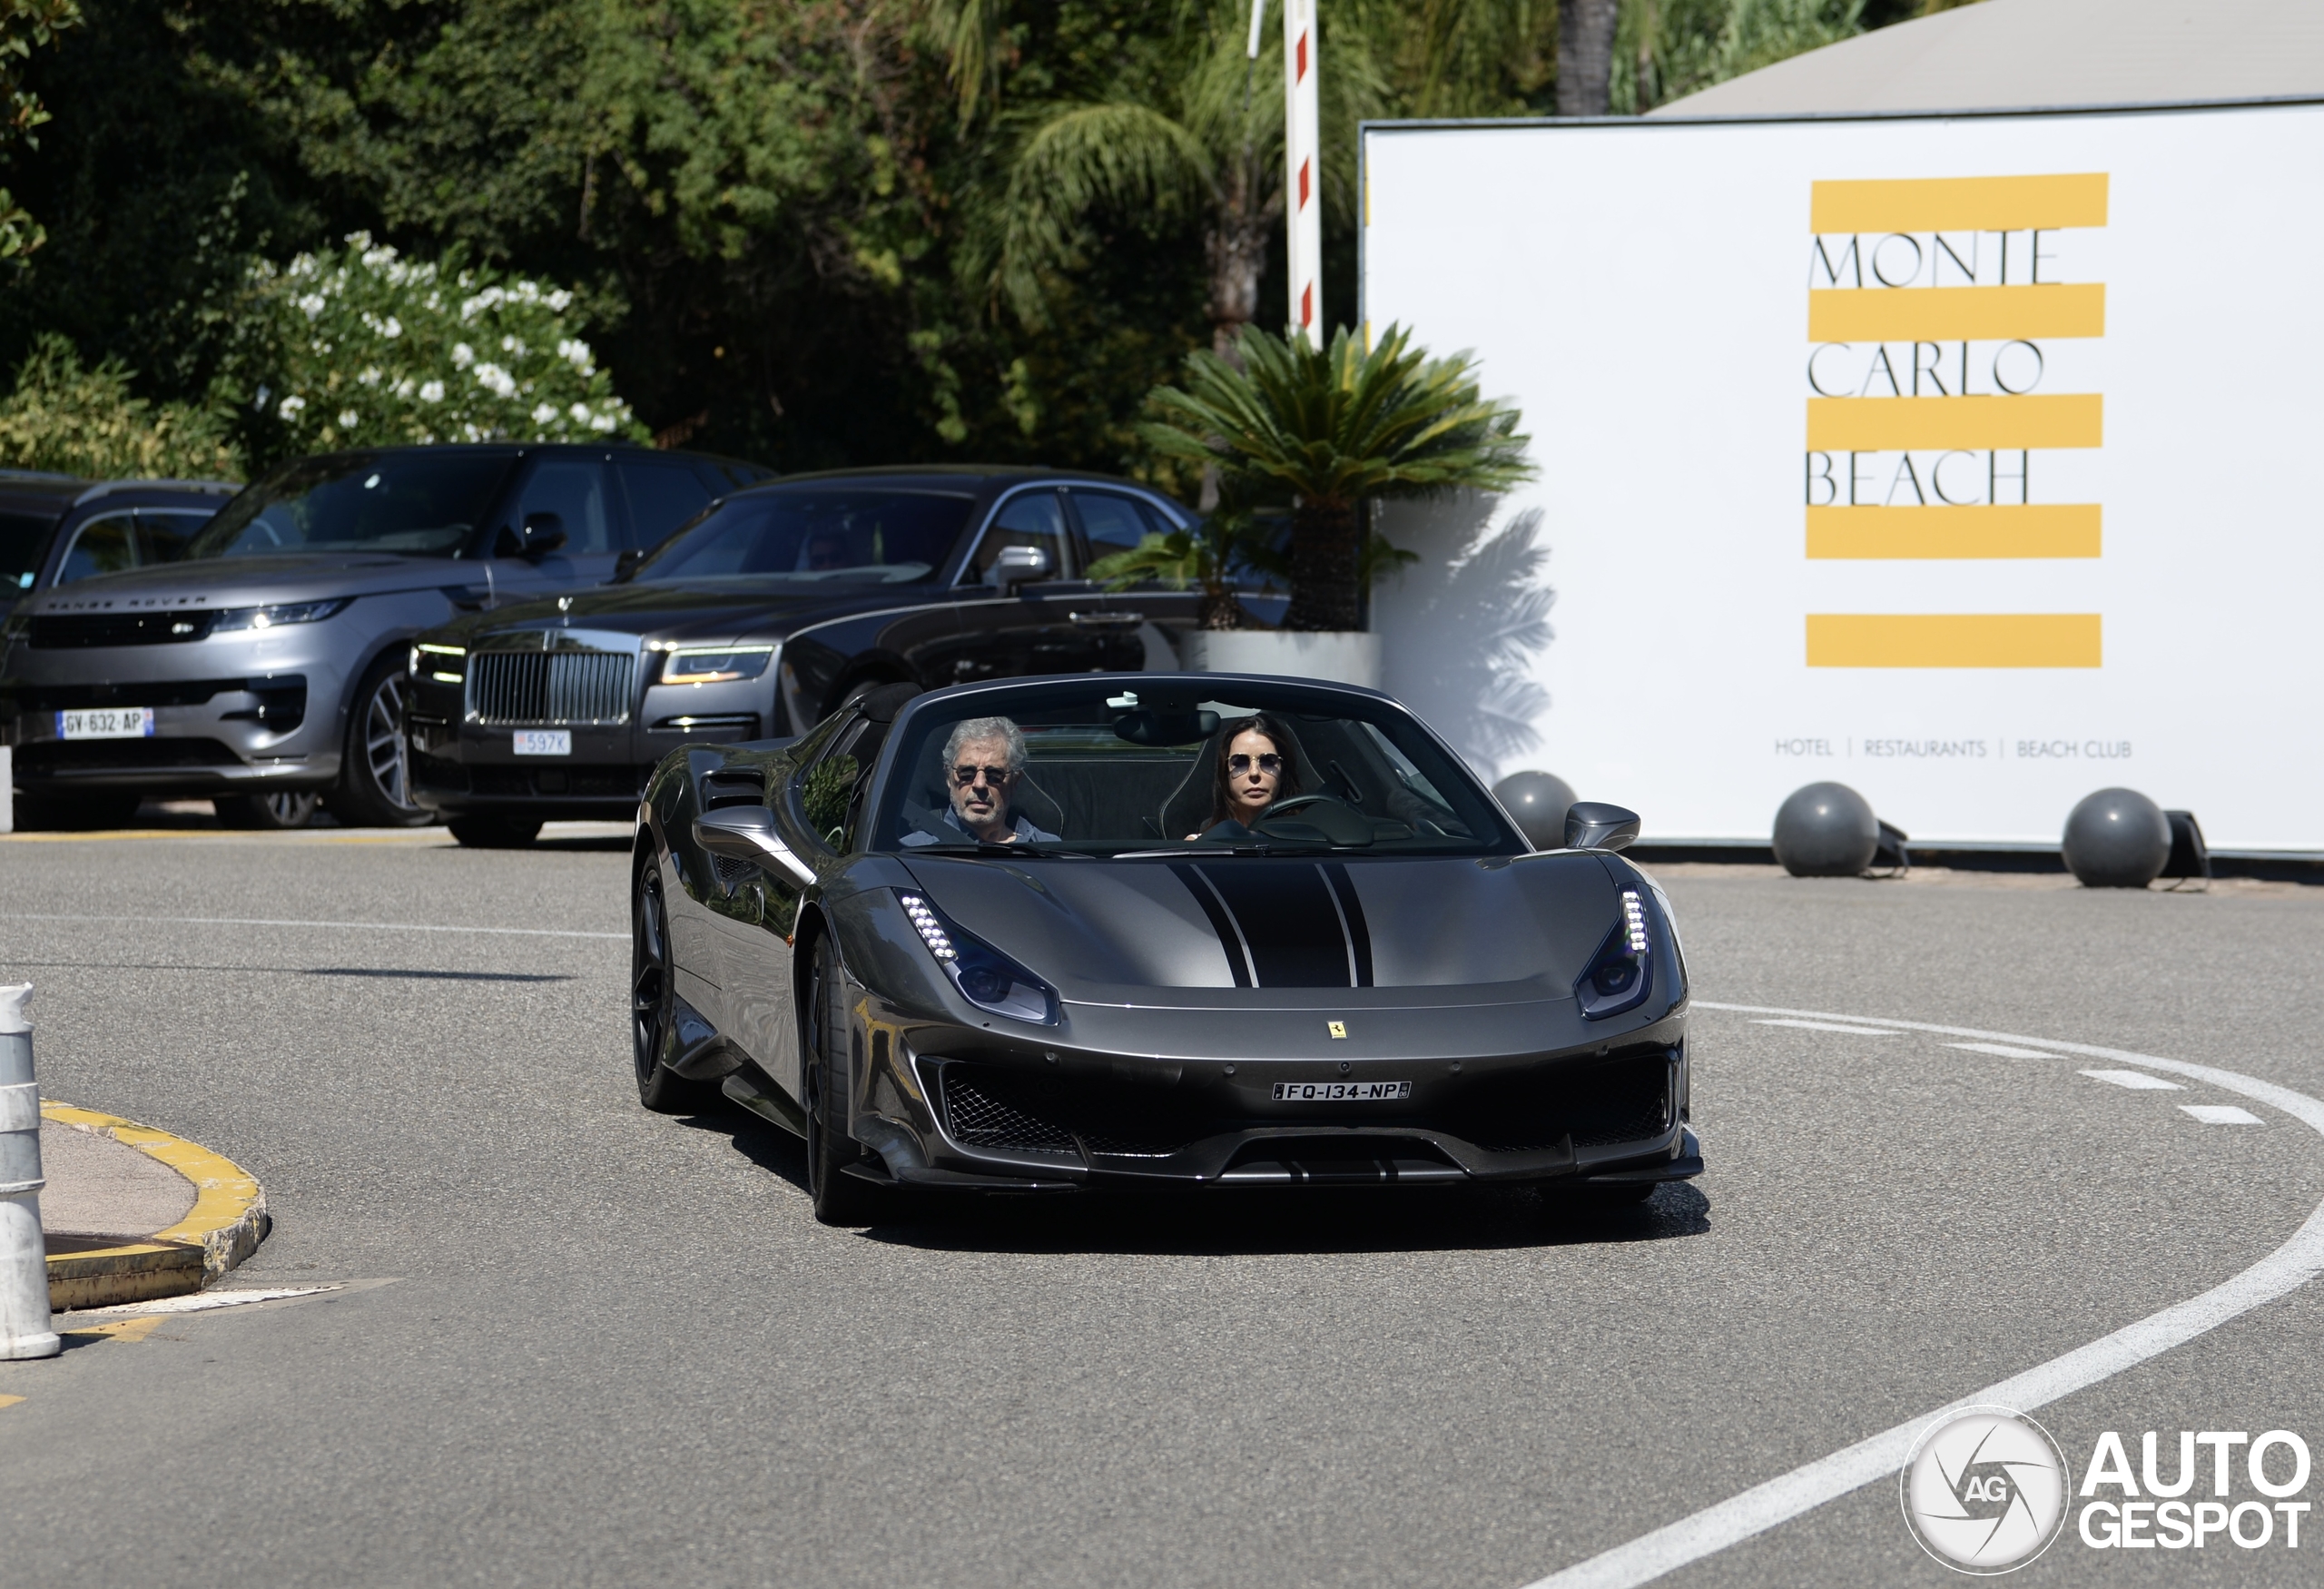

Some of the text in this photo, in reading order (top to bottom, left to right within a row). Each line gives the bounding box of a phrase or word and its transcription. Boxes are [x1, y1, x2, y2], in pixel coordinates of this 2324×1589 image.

[1808, 227, 2062, 289] MONTE
[1808, 339, 2043, 398] CARLO
[1806, 449, 2028, 507] BEACH
[1775, 738, 2132, 758] HOTEL RESTAURANTS BEACH CLUB
[1286, 1083, 1397, 1099] FQ-134-NP
